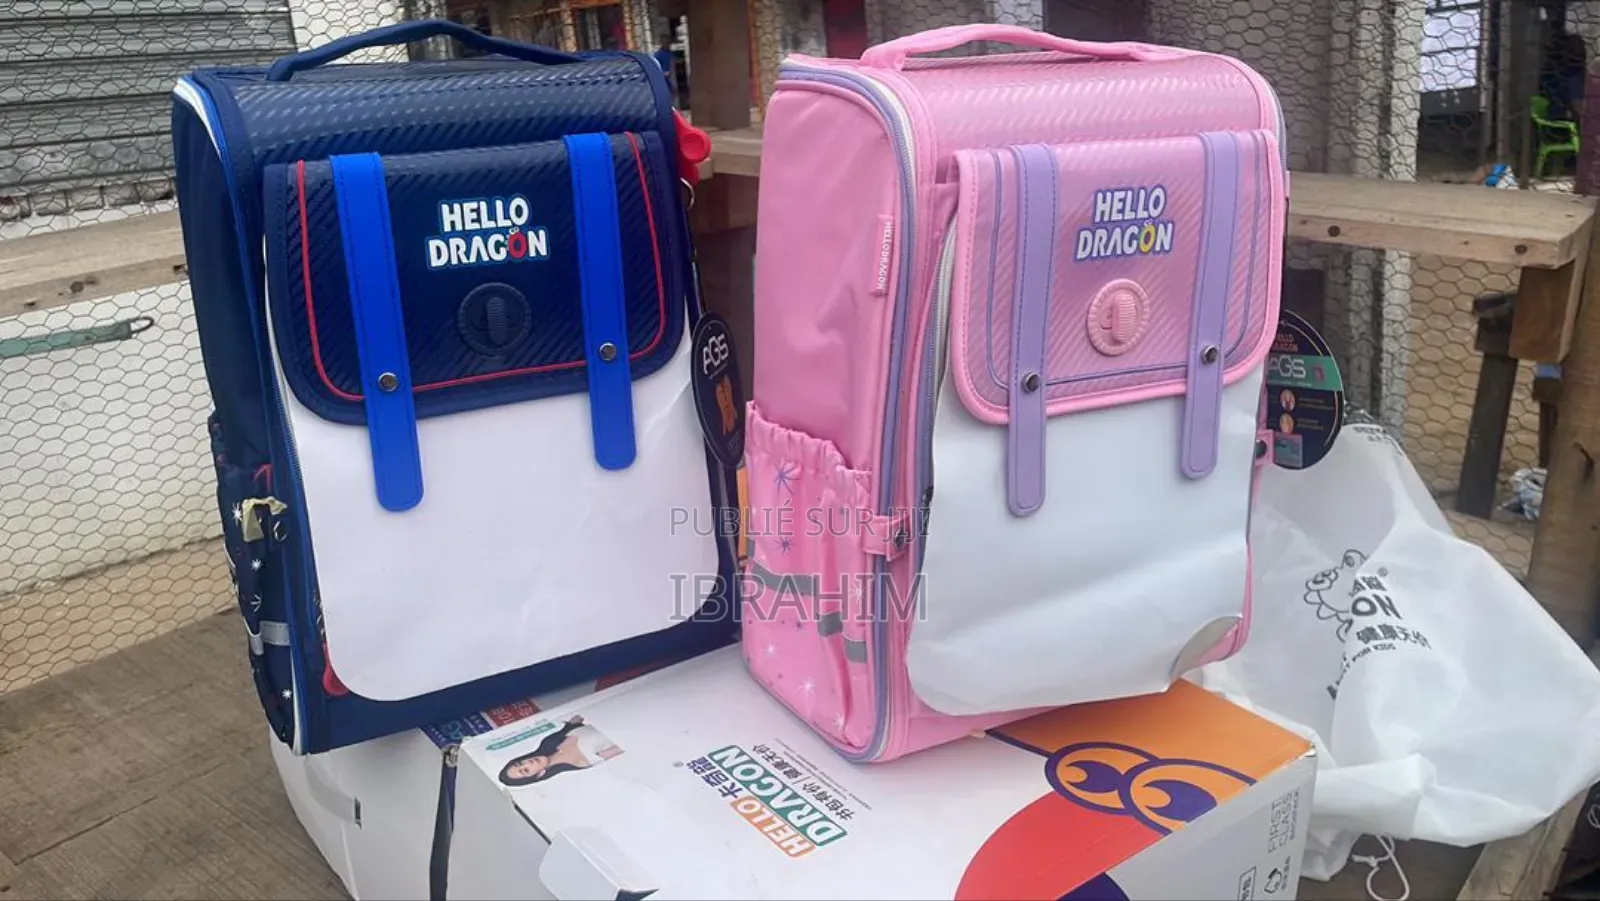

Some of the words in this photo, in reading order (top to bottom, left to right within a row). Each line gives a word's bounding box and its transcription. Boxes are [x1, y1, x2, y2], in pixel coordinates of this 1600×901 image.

[440, 197, 529, 232] HELLO
[1094, 187, 1166, 222] HELLO
[428, 229, 548, 267] DRAGON
[877, 221, 892, 290] HELLODRAGON
[1076, 222, 1174, 260] DRAGON
[735, 798, 812, 856] HELLO
[1268, 797, 1282, 853] FIRST
[1279, 792, 1292, 847] CLASS
